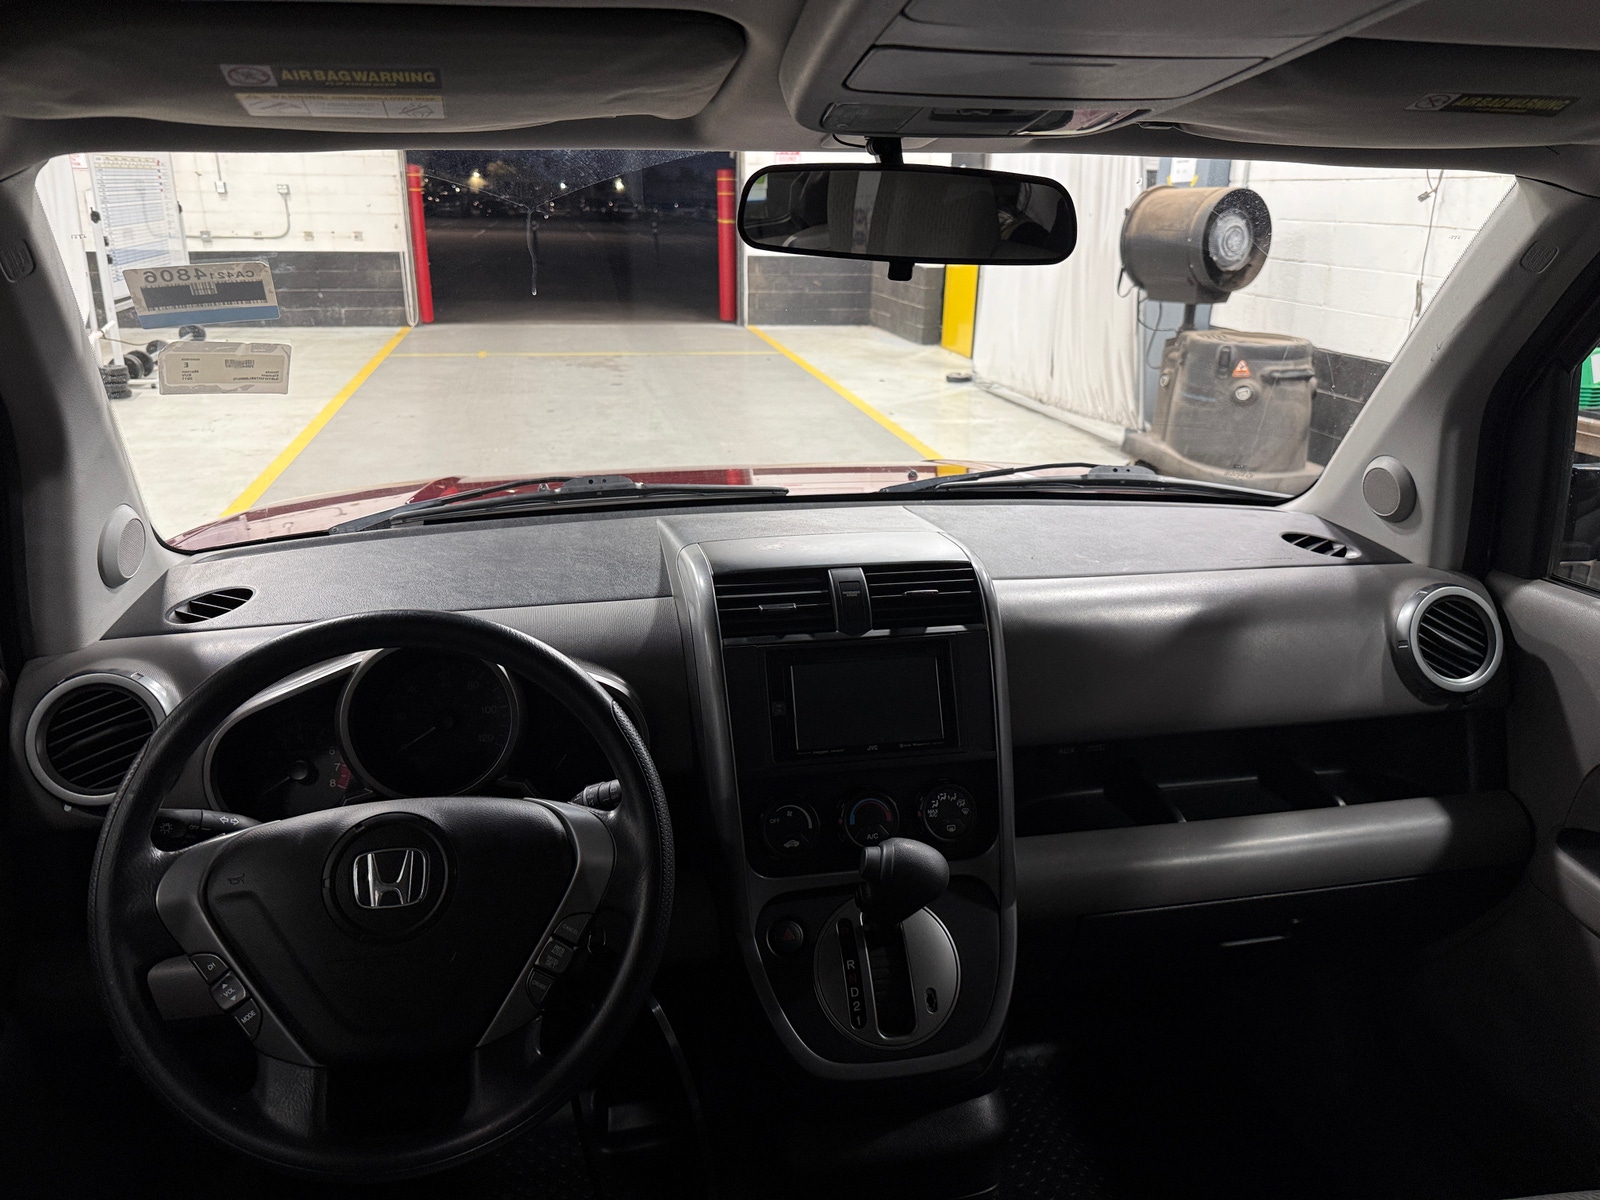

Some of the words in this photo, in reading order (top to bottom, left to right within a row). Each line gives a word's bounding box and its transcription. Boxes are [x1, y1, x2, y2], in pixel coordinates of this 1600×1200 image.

[352, 71, 436, 83] WARNING
[481, 705, 497, 715] 100
[478, 733, 495, 743] 120
[329, 746, 336, 755] 6
[866, 744, 879, 752] JVC
[334, 762, 341, 772] 7
[329, 778, 336, 788] 8
[866, 833, 879, 841] A/C
[207, 961, 216, 971] CH
[846, 959, 856, 970] R
[222, 987, 236, 998] VOL
[850, 986, 860, 998] D
[852, 1000, 861, 1012] 2
[240, 1010, 257, 1024] MODE
[856, 1015, 861, 1026] 1
